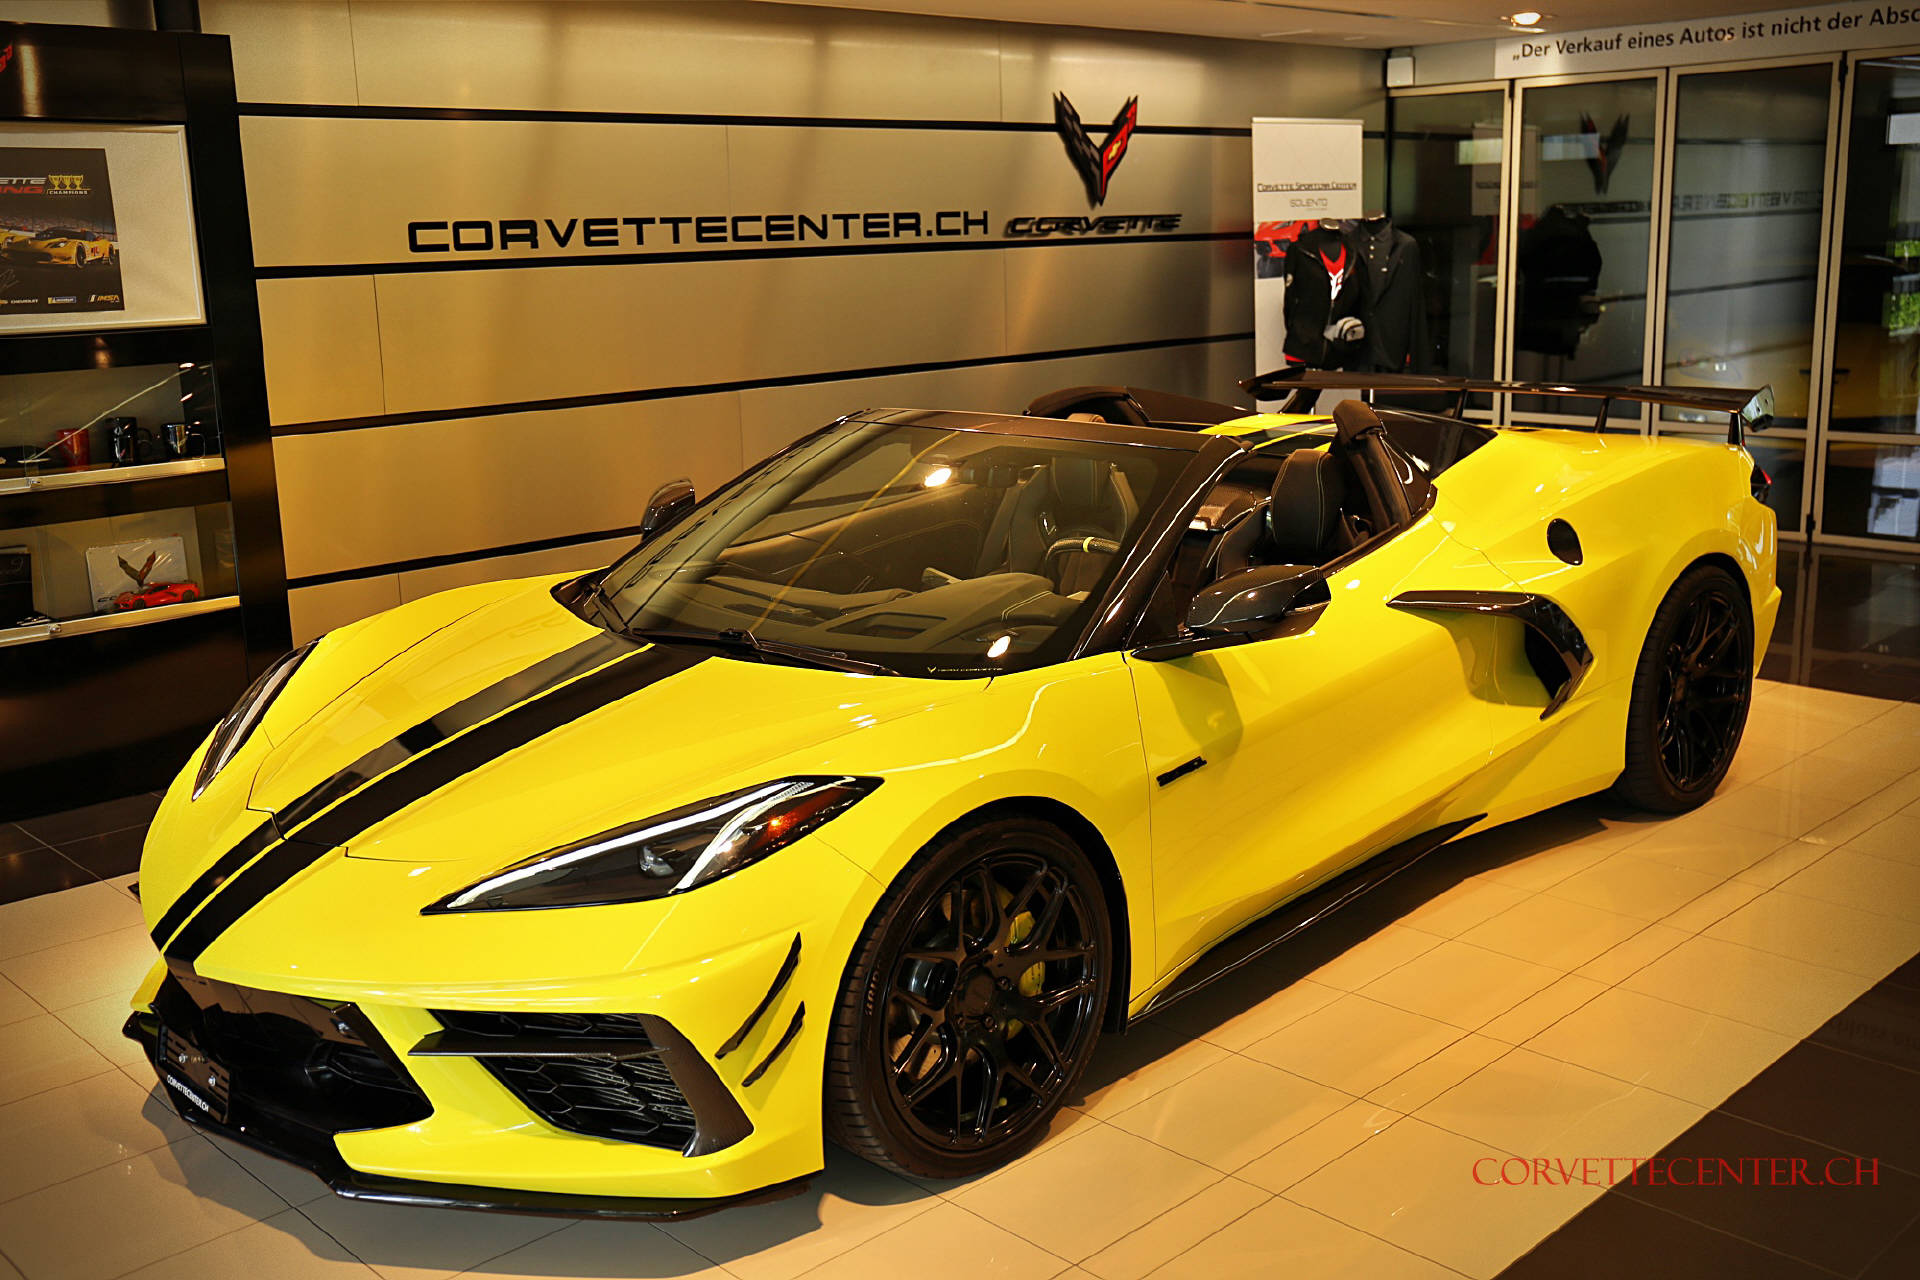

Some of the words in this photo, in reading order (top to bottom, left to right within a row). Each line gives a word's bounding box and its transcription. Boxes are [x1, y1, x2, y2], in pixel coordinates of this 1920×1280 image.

[1556, 33, 1623, 55] Verkauf
[1627, 32, 1674, 50] eines
[1680, 27, 1736, 45] Autos
[1742, 22, 1765, 39] ist
[1771, 16, 1822, 36] nicht
[1827, 12, 1863, 31] der
[407, 210, 989, 253] CORVETTECENTER.CH
[1008, 213, 1183, 235] CORVETTE
